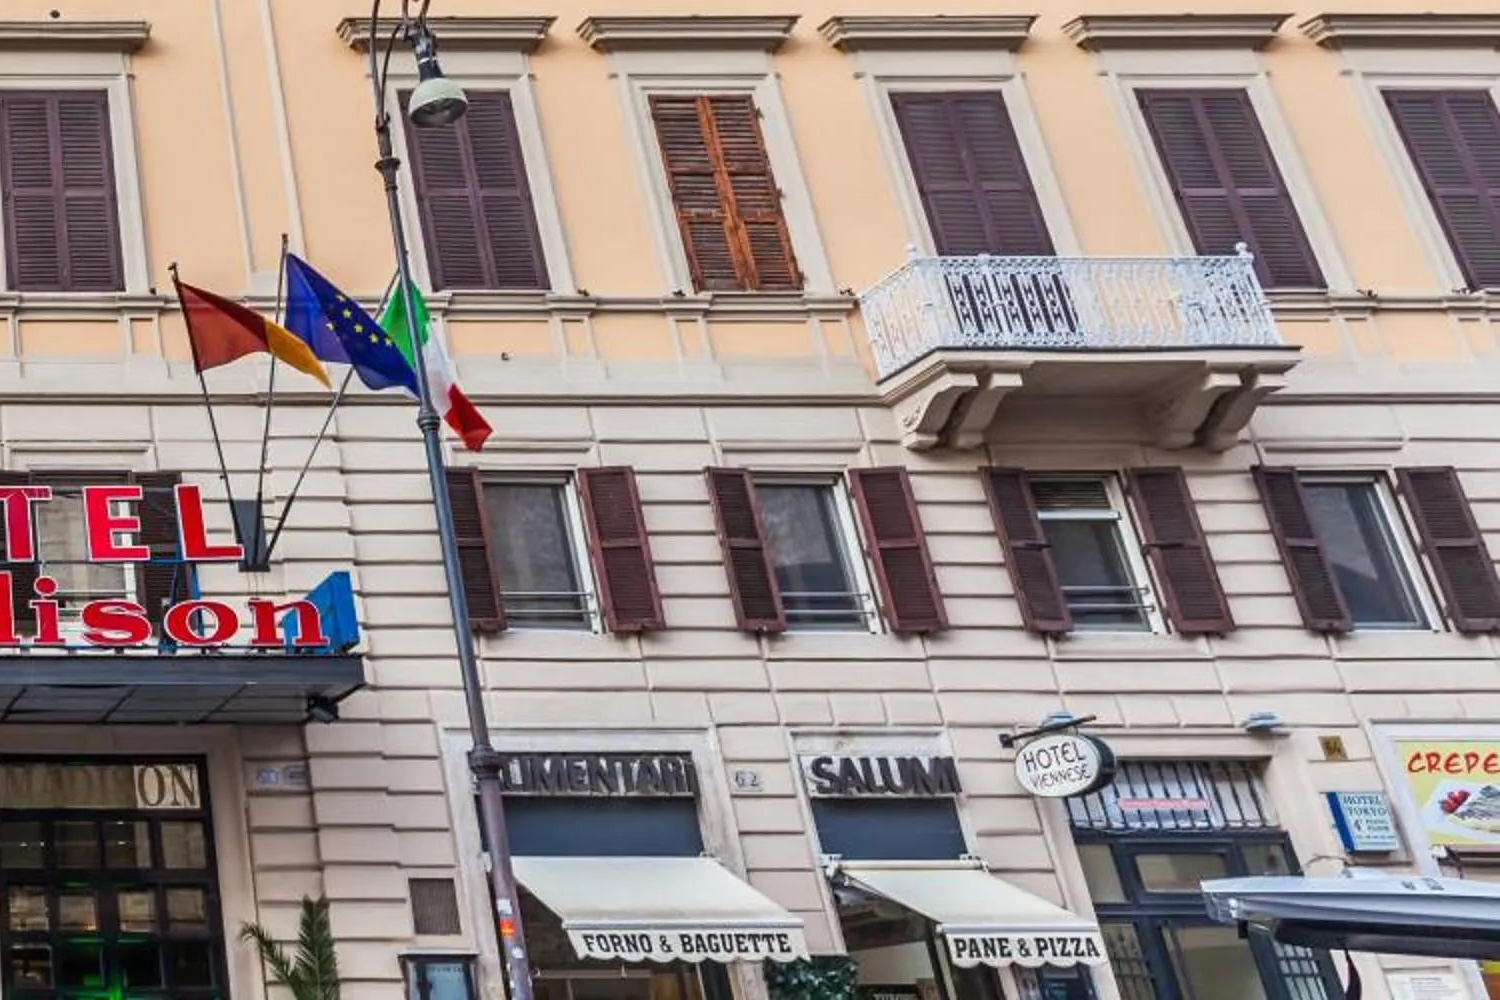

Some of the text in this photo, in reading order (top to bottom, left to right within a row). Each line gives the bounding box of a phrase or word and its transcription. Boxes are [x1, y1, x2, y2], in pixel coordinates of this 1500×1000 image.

[1023, 741, 1086, 772] HOTEL
[498, 755, 700, 794] LIMENTARI
[811, 755, 962, 795] SALUMI
[1031, 763, 1091, 788] VIENNESE
[582, 933, 792, 953] FORNO & BAGUETTE
[953, 937, 1100, 958] PANE & PIZZA
